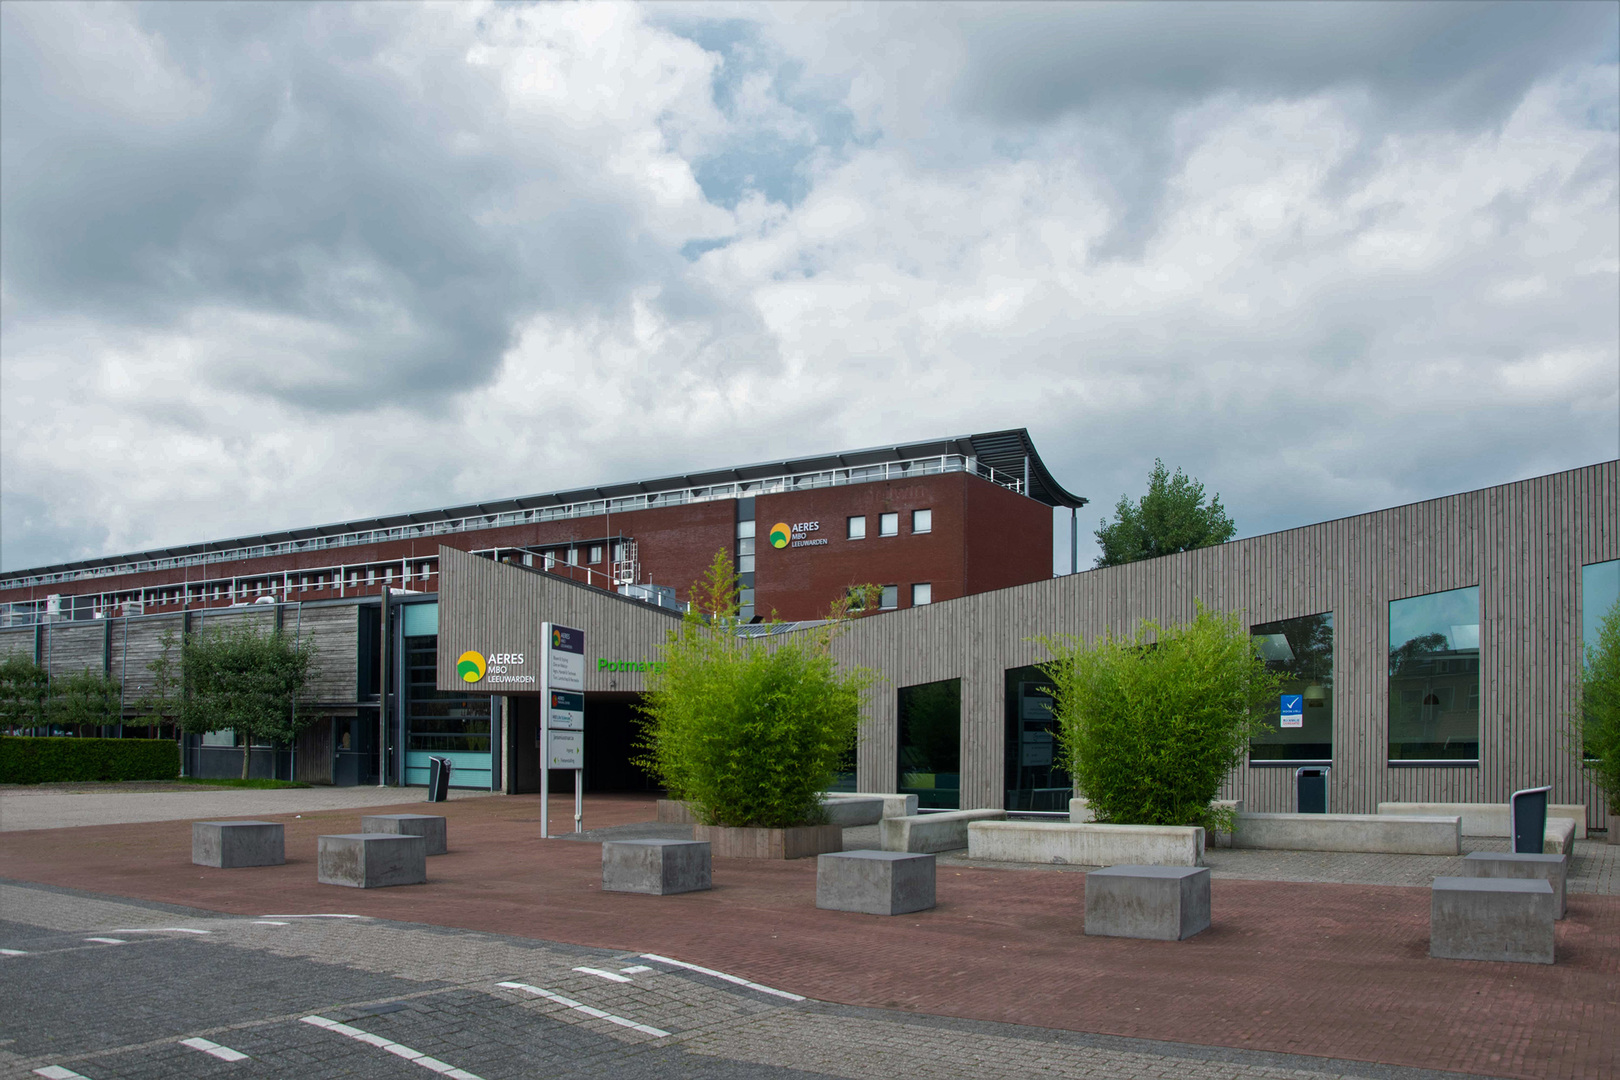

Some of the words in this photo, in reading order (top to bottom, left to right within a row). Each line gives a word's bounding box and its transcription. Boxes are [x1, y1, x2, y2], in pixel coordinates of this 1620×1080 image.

[792, 521, 820, 532] AERES
[792, 532, 807, 540] MBO
[792, 538, 828, 548] LEEUWARDEN
[488, 653, 524, 664] AERES
[488, 665, 507, 674] MBO
[488, 675, 535, 683] LEEUWARDEN
